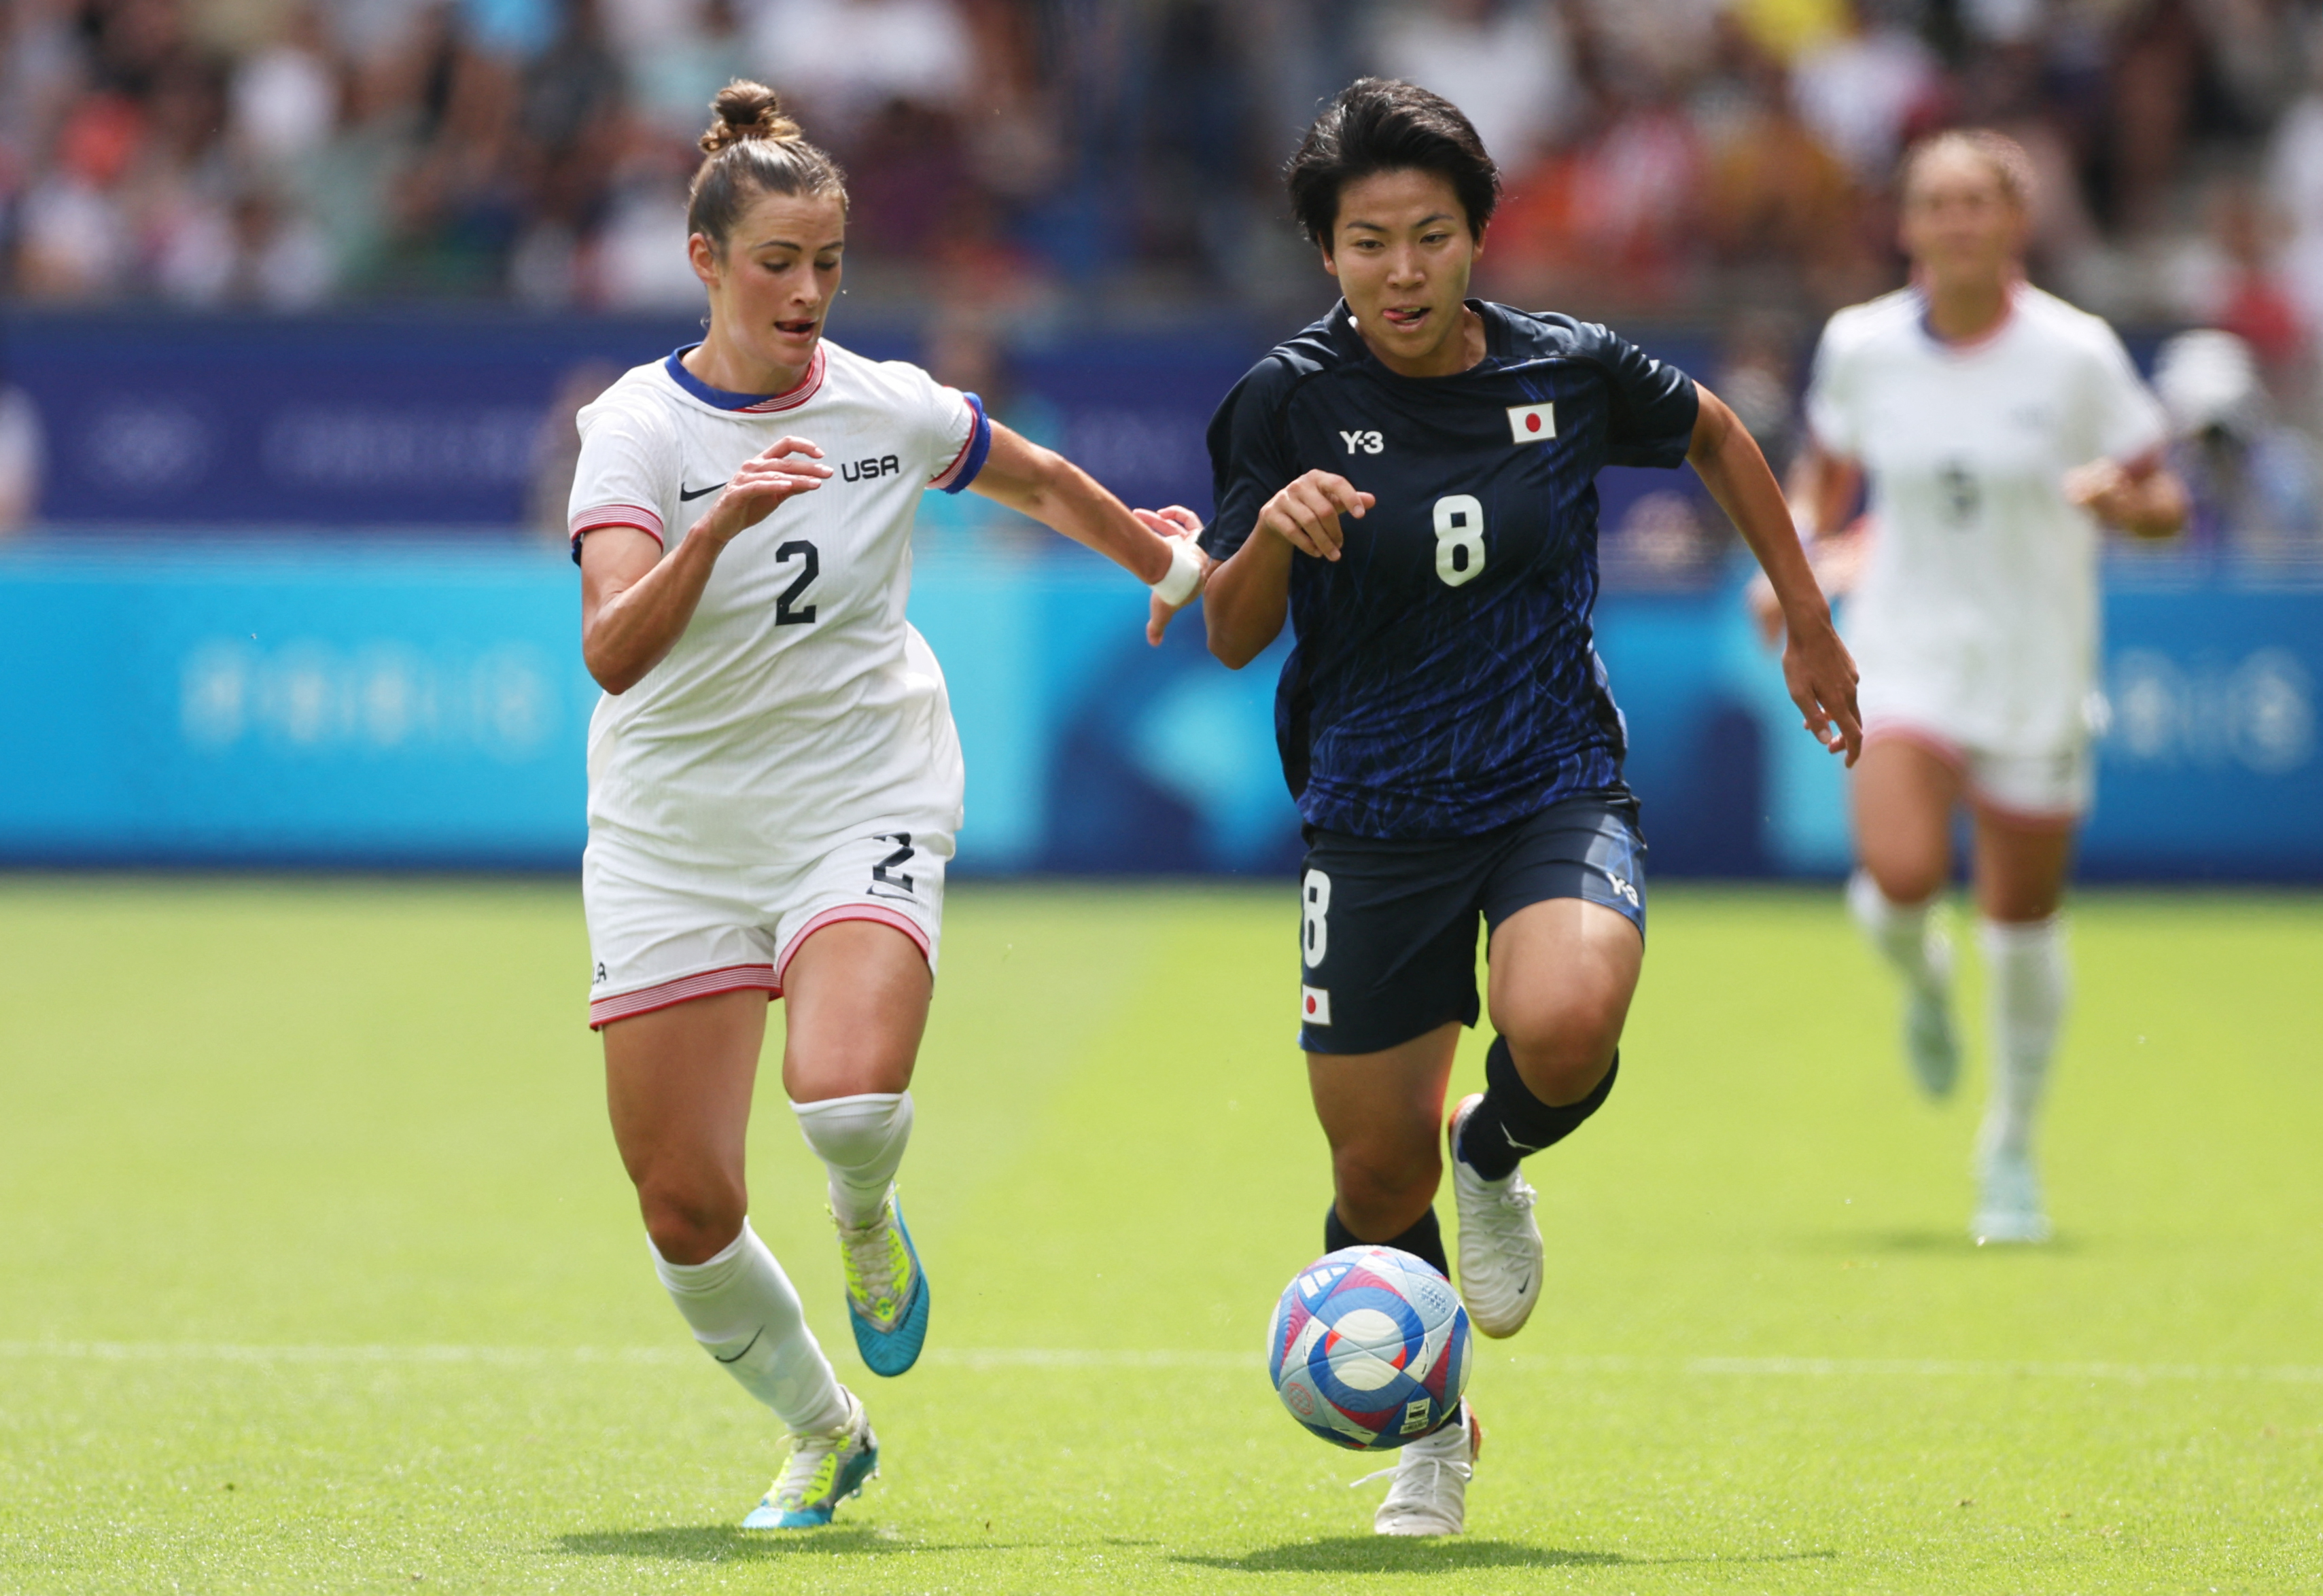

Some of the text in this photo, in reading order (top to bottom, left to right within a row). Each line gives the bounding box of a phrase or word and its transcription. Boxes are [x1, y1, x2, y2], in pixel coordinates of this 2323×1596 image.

[841, 455, 899, 482] USA
[1340, 430, 1384, 454] Y-3
[1433, 494, 1486, 587] 8
[775, 539, 819, 626] 2
[873, 832, 915, 893] 2
[1303, 868, 1331, 968] 8
